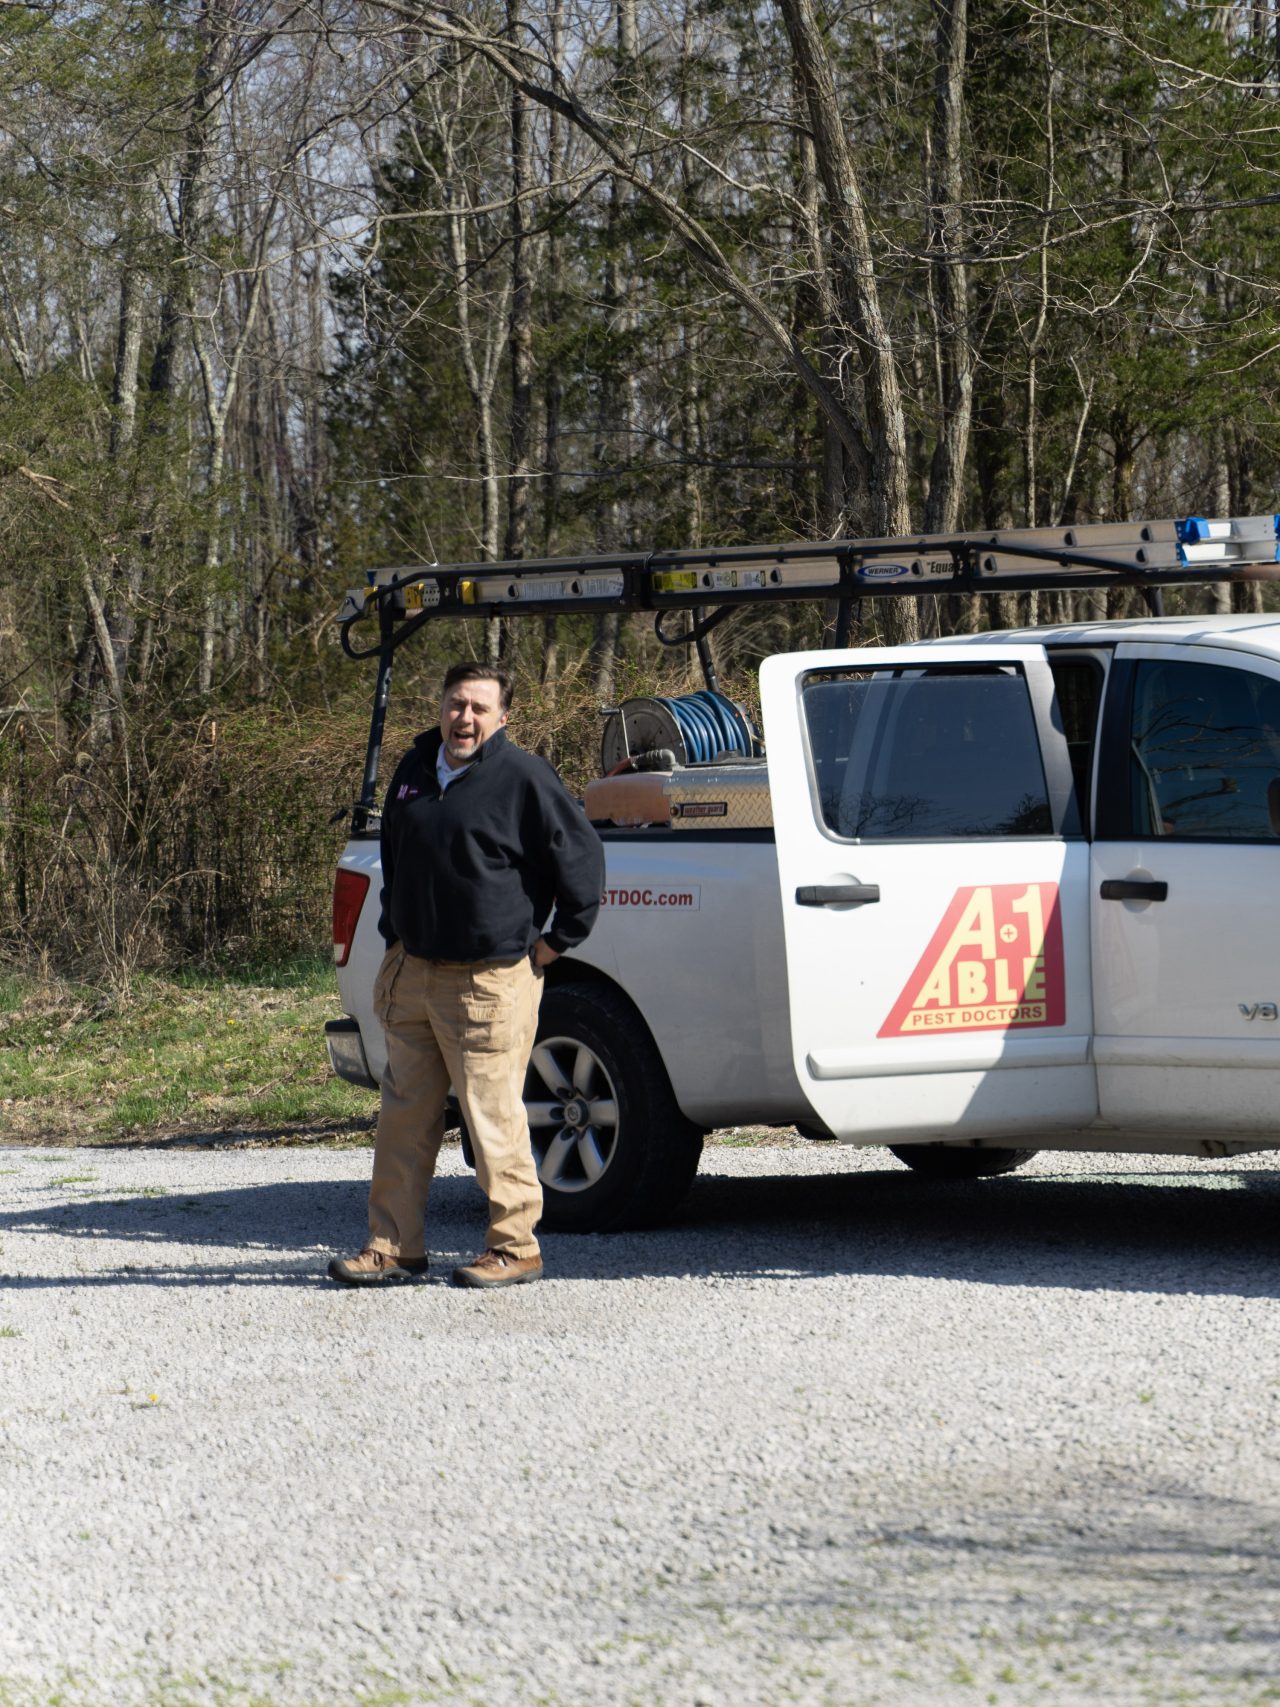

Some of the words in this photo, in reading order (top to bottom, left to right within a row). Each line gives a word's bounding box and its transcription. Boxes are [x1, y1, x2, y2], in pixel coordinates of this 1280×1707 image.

[868, 567, 899, 575] WERNER
[912, 957, 1046, 1008] ABLE
[912, 1011, 956, 1026] PEST
[962, 1005, 1043, 1023] DOCTORS
[1238, 1001, 1278, 1021] V8
